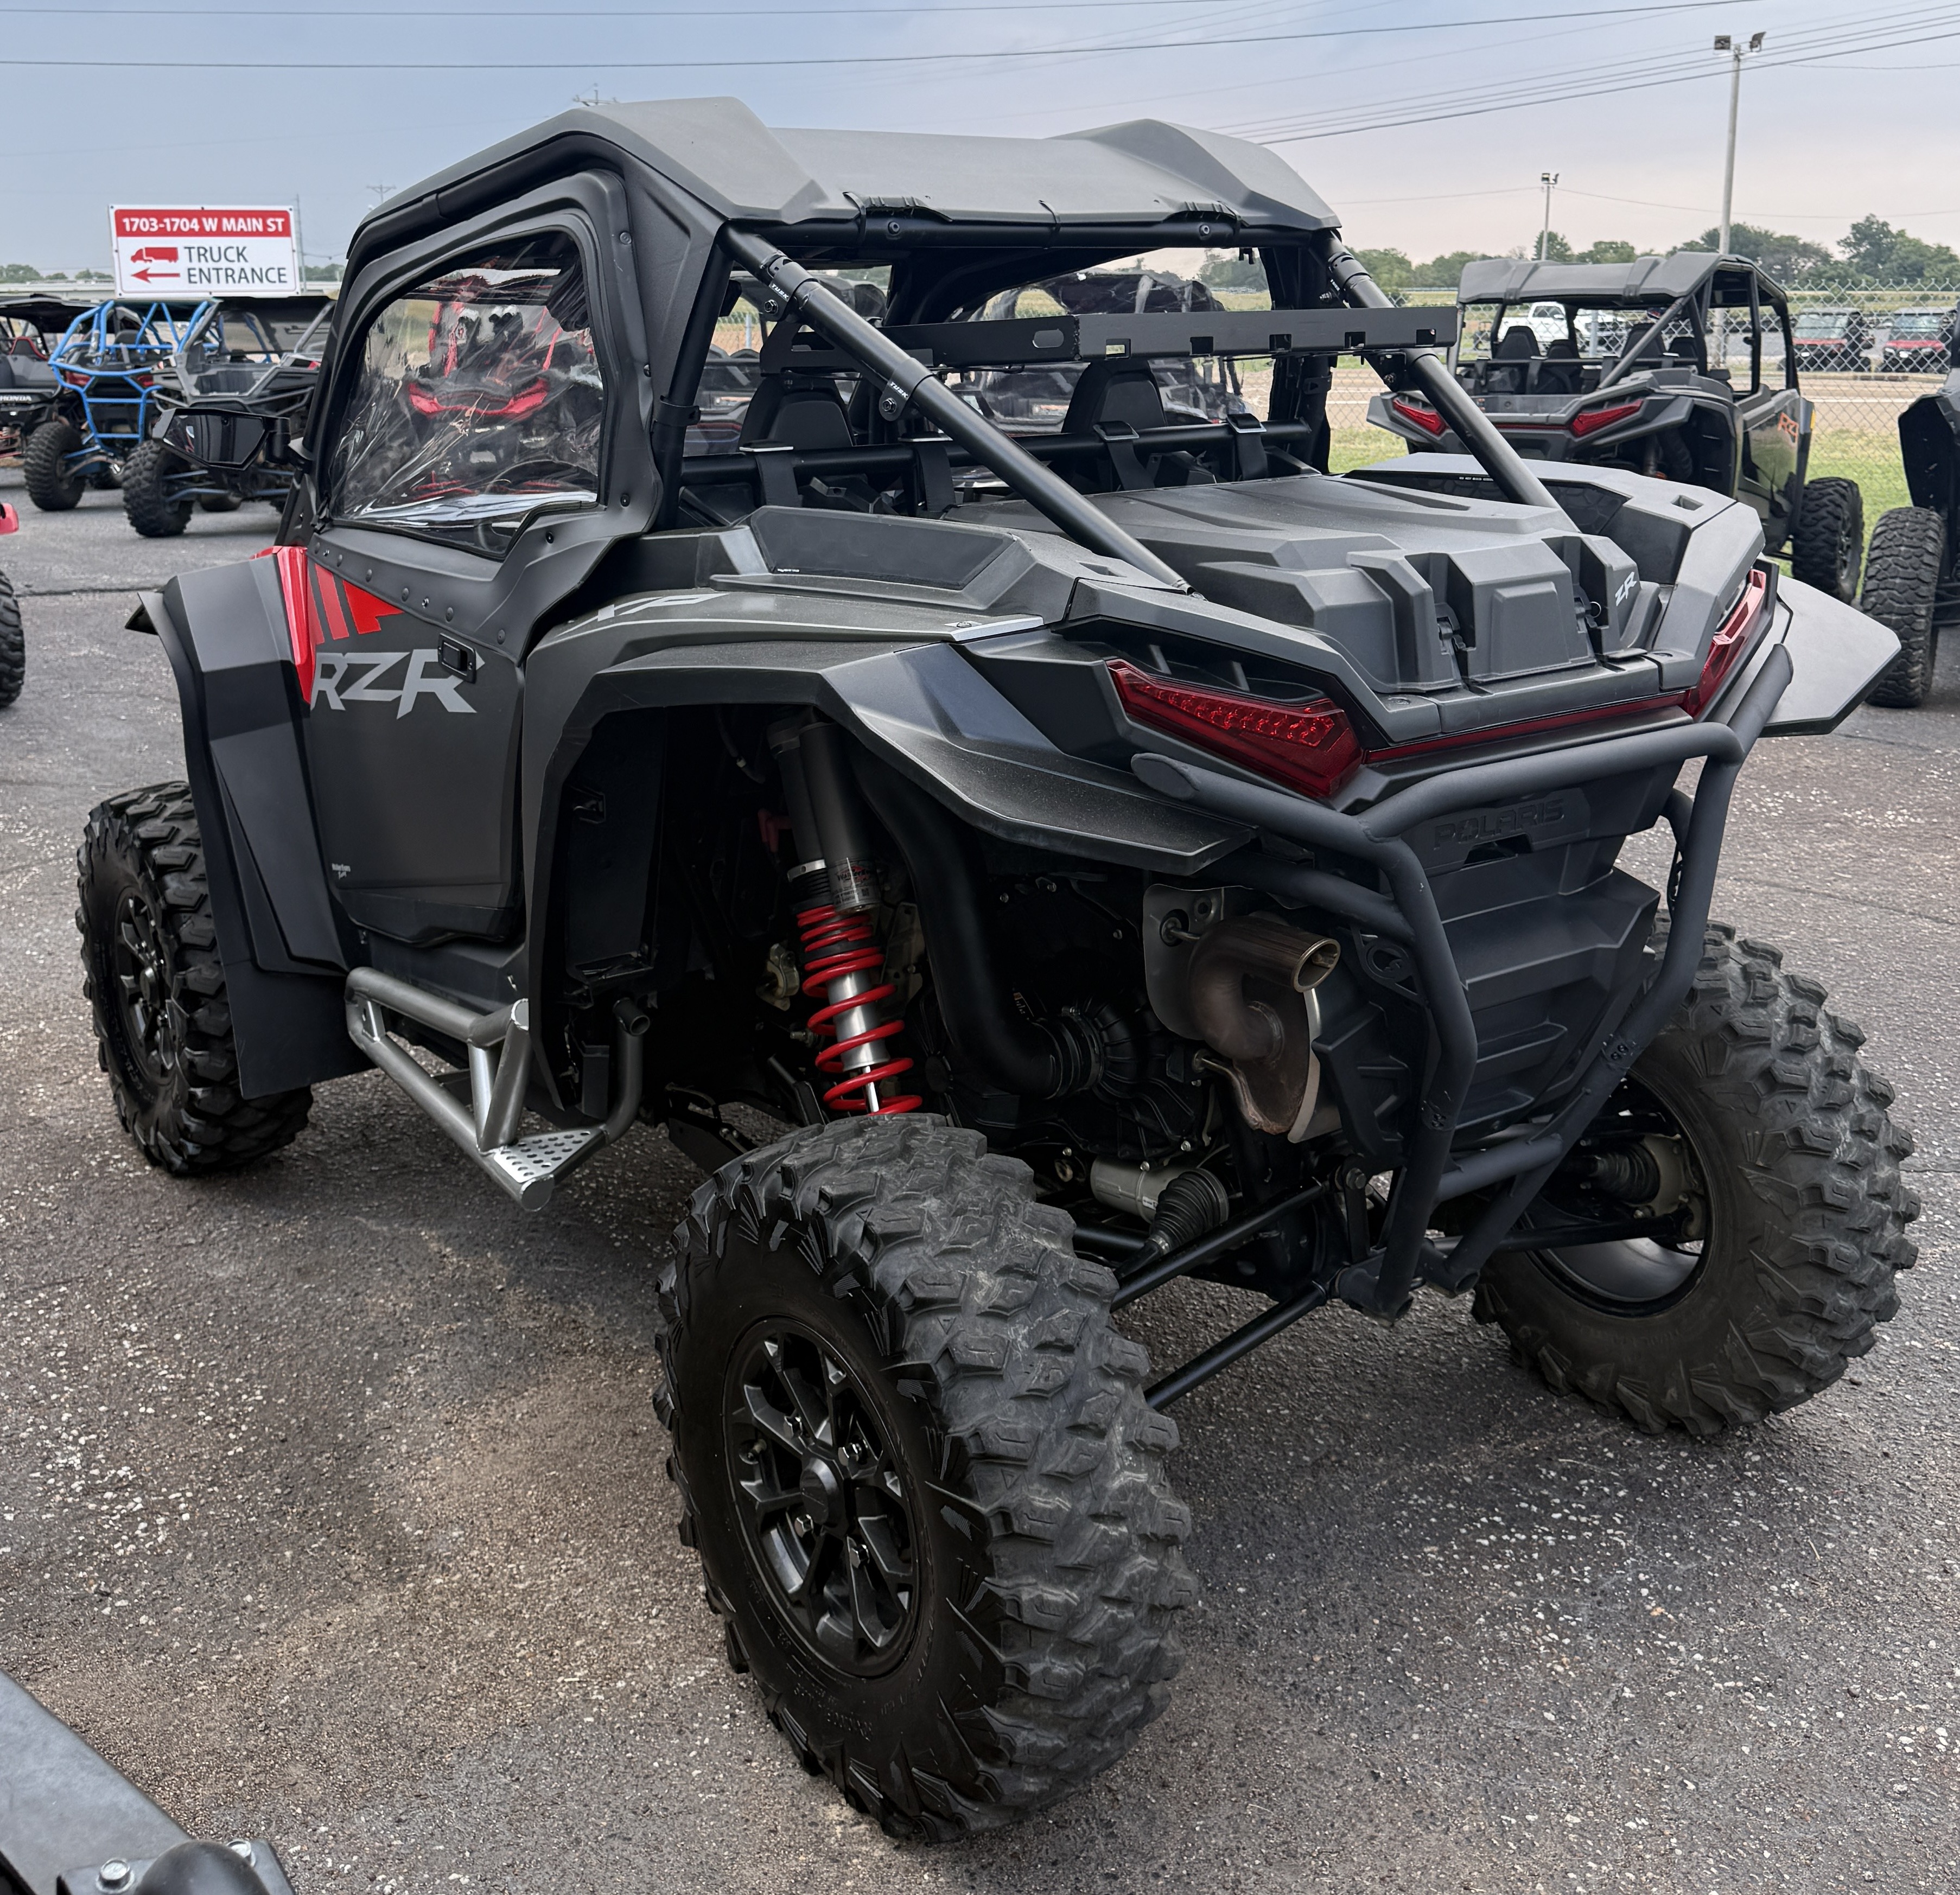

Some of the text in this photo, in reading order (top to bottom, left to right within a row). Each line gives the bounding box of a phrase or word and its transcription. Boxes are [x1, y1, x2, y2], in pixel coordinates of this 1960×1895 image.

[122, 218, 285, 232] 1703-1704 W MAIN ST
[184, 246, 249, 263] TRUCK
[187, 267, 288, 284] ENTRANCE
[310, 649, 485, 719] RZR
[1434, 798, 1565, 850] POLARIS
